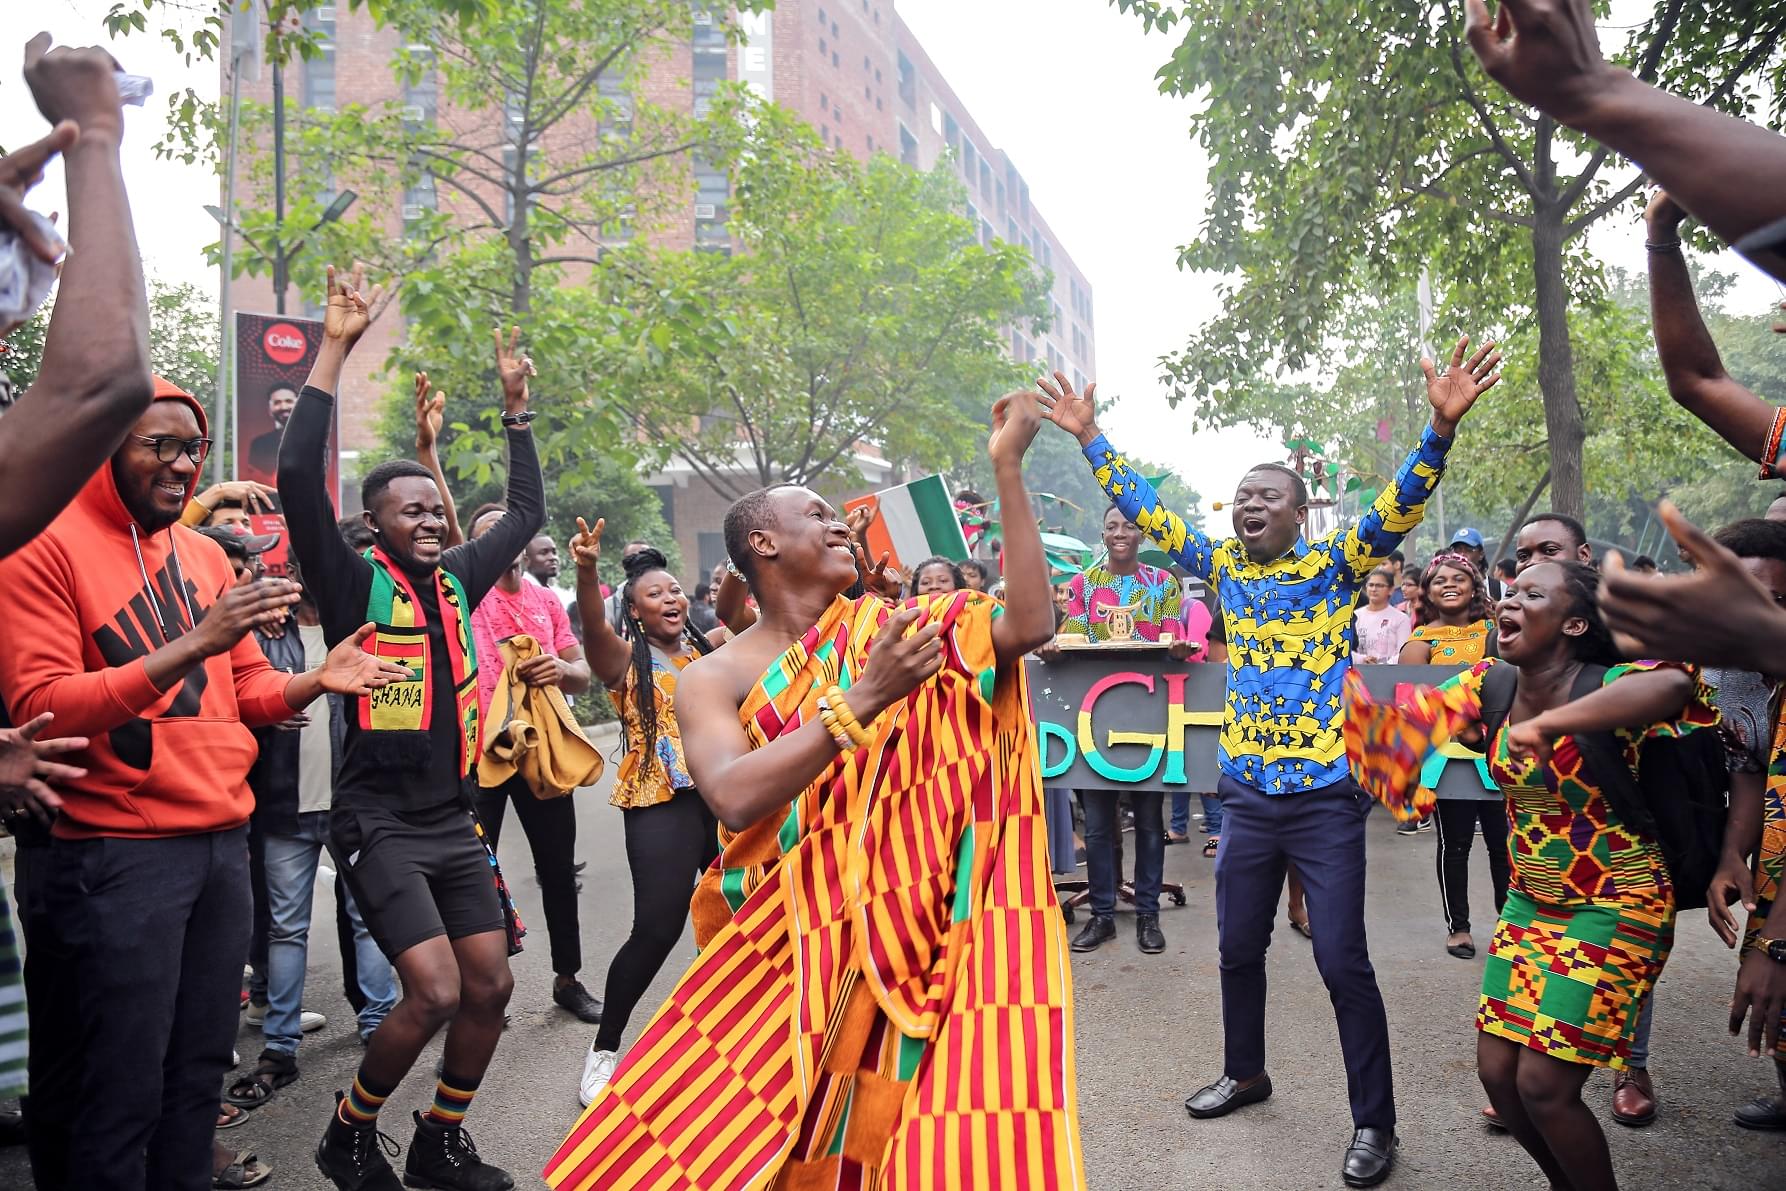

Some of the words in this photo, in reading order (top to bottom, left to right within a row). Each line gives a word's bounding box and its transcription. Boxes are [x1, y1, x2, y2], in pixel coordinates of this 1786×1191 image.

[268, 333, 303, 349] Coke
[91, 551, 209, 668] NIKE
[371, 684, 422, 710] GHANA
